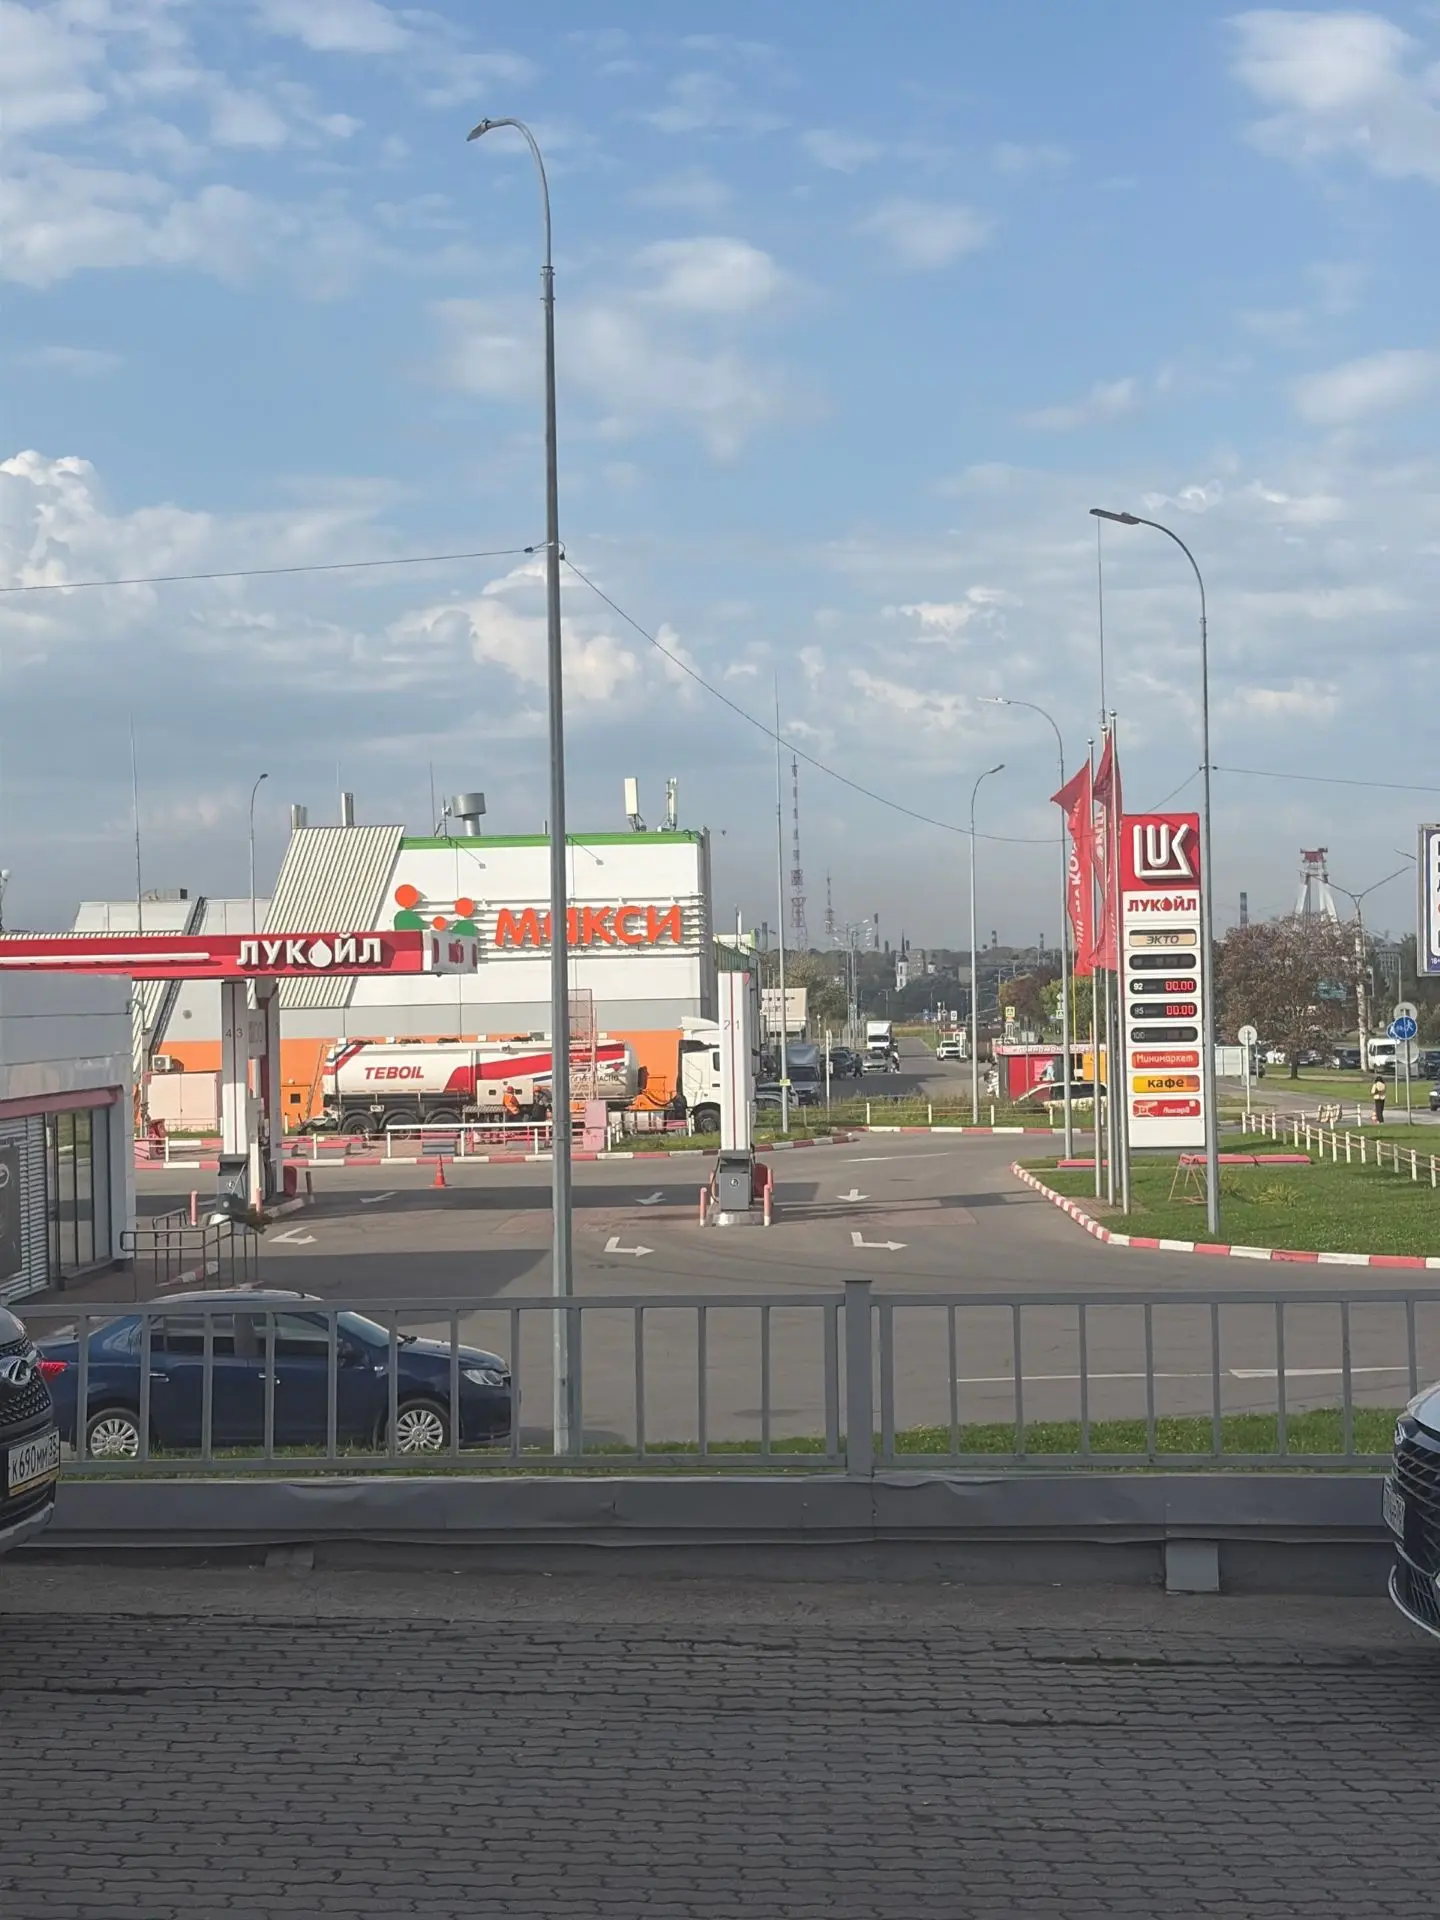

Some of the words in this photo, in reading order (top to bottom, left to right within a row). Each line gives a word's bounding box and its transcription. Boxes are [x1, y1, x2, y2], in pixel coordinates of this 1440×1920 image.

[1127, 896, 1197, 912] ЛУКОЙЛ
[1146, 935, 1180, 945] ЭКТО
[236, 932, 382, 967] ЛУКОЙЛ
[1133, 983, 1144, 991] 92
[1165, 981, 1194, 991] 00.00
[1166, 1005, 1195, 1015] 00.00
[225, 1028, 232, 1038] 4
[236, 1028, 243, 1038] 3
[364, 1066, 425, 1080] TEBOIL
[1147, 1078, 1185, 1088] кафе
